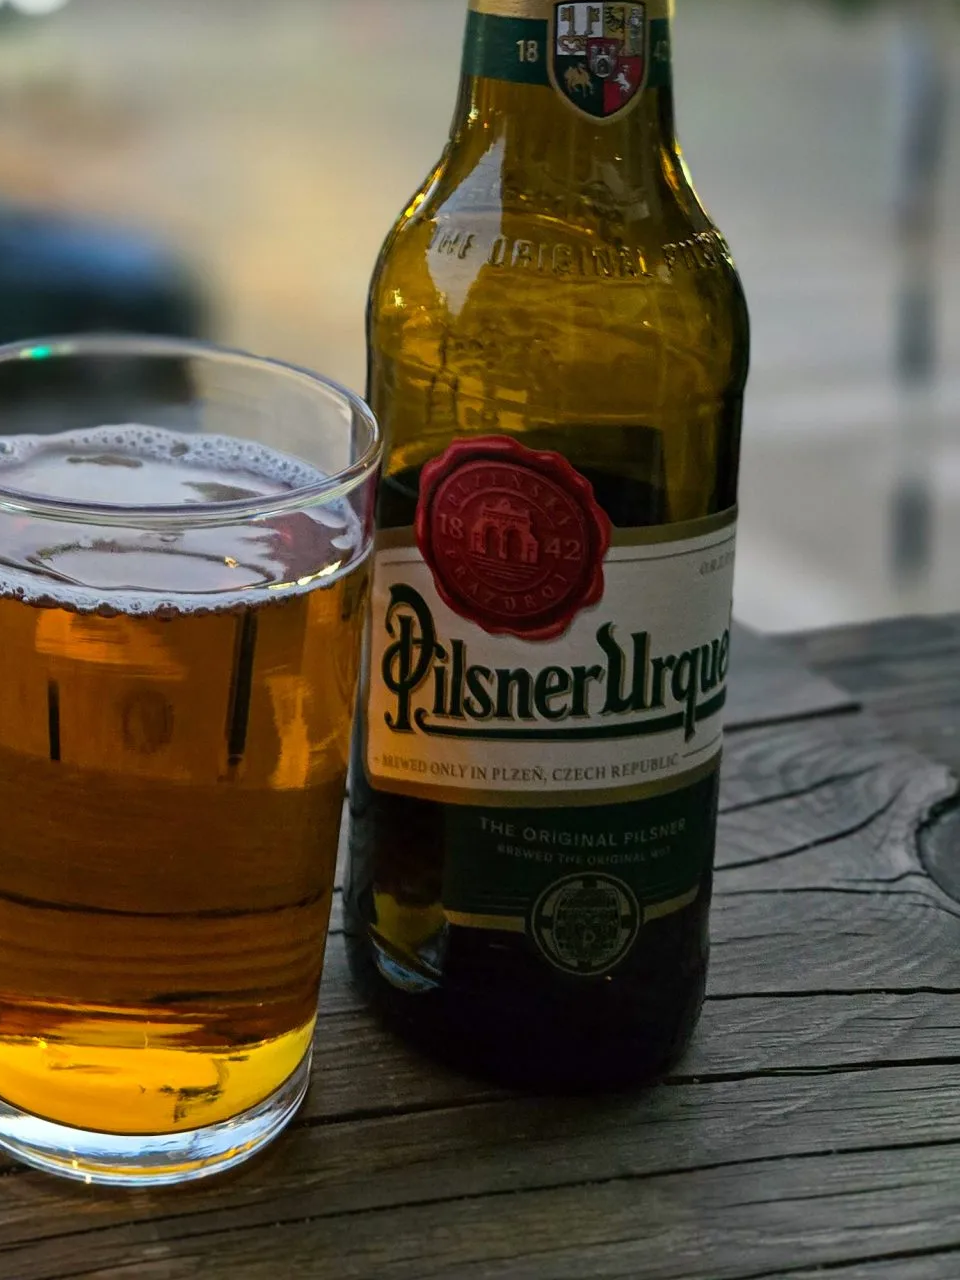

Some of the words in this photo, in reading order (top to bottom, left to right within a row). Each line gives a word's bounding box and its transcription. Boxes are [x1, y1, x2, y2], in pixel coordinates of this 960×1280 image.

[515, 39, 539, 62] 18
[488, 236, 653, 278] ORIGINAL
[438, 513, 465, 540] 18
[544, 537, 582, 563] 42
[381, 582, 604, 734] Pilsner
[382, 753, 428, 774] BREWED
[430, 761, 468, 779] ONLY
[471, 765, 487, 781] IN
[552, 766, 606, 781] CZECH
[611, 752, 679, 778] REPUBLIC
[478, 816, 518, 838] THE
[522, 825, 618, 849] ORIGINAL
[623, 816, 686, 846] PILSNER
[556, 852, 584, 865] THE
[586, 851, 646, 867] ORIGINAL
